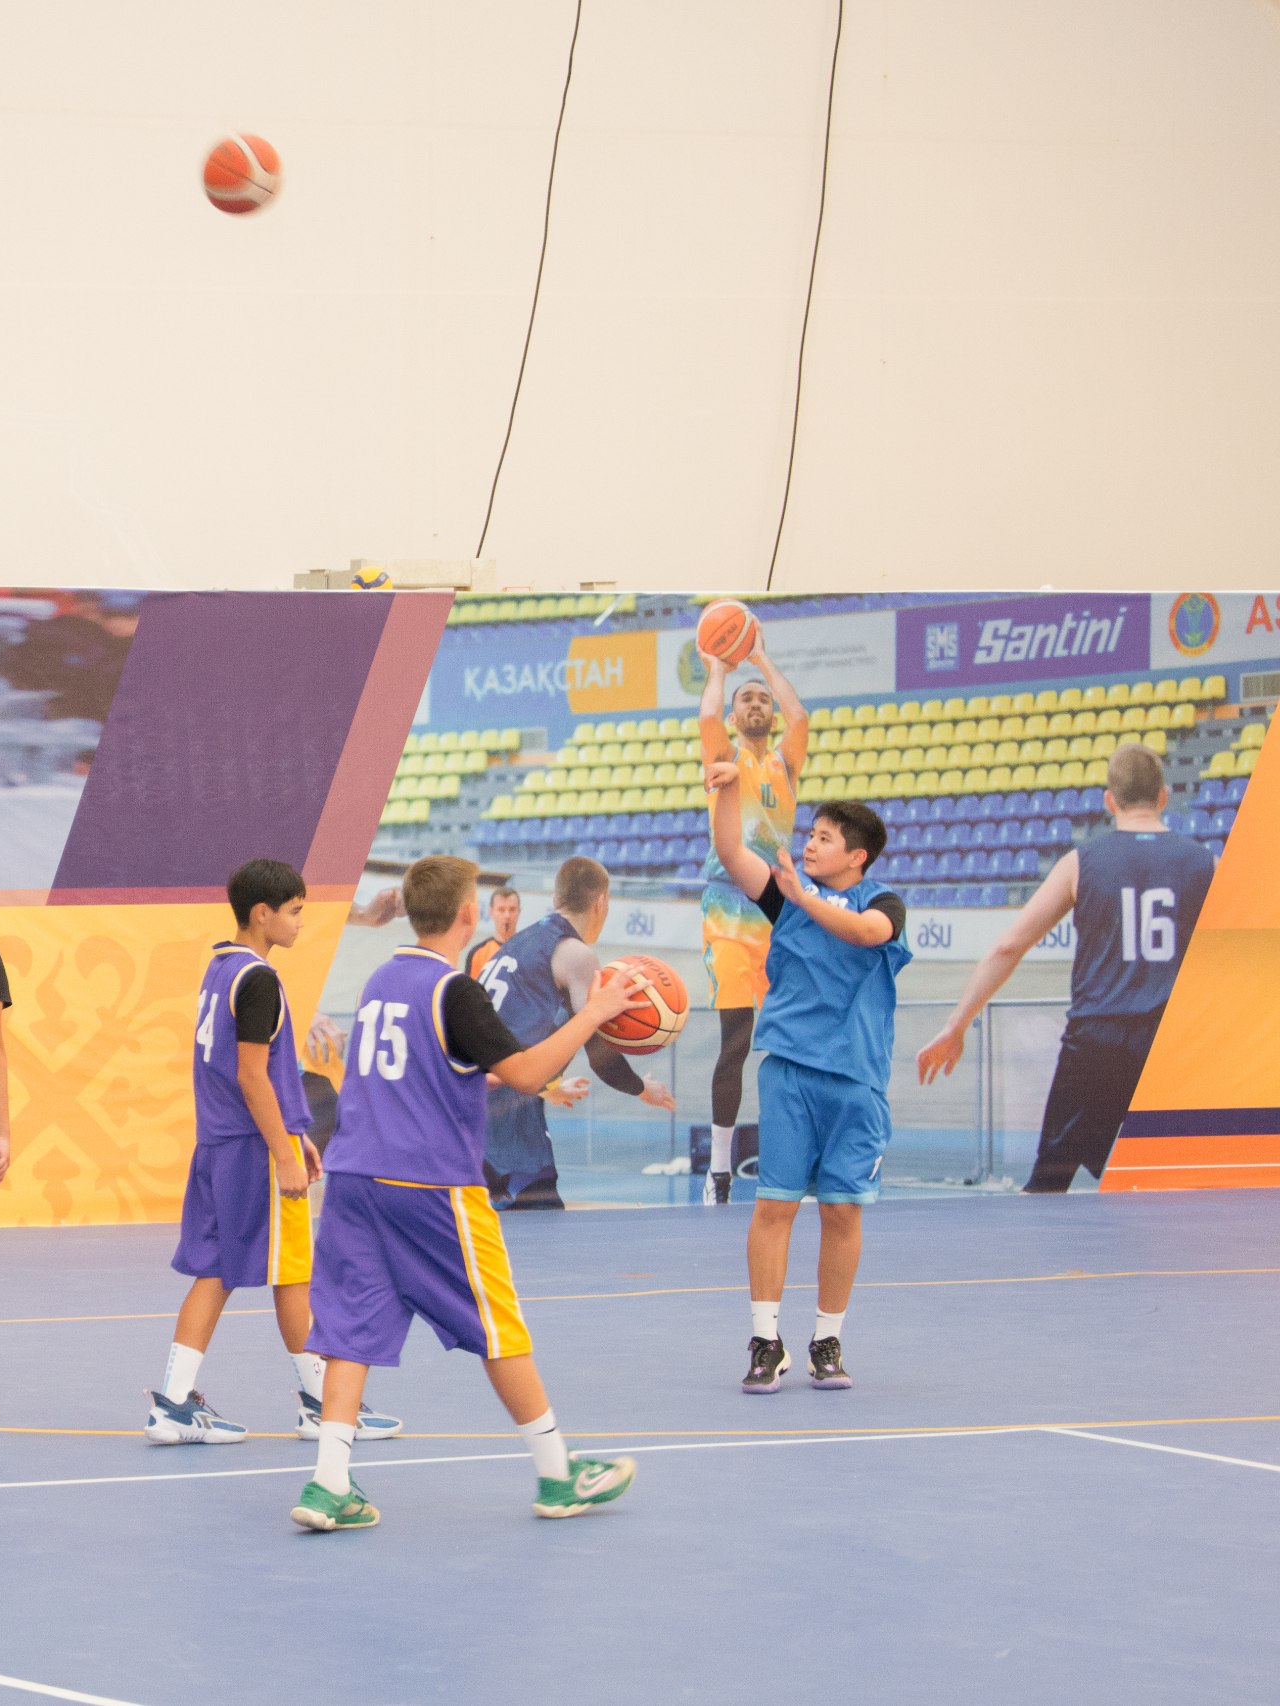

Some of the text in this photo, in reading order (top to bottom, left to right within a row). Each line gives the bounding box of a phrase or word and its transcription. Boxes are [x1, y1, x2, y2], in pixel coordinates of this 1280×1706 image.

[973, 607, 1128, 664] Santini
[463, 656, 624, 701] ҚАЗАҚСТАН
[1121, 887, 1176, 962] 16
[357, 1000, 410, 1080] 15
